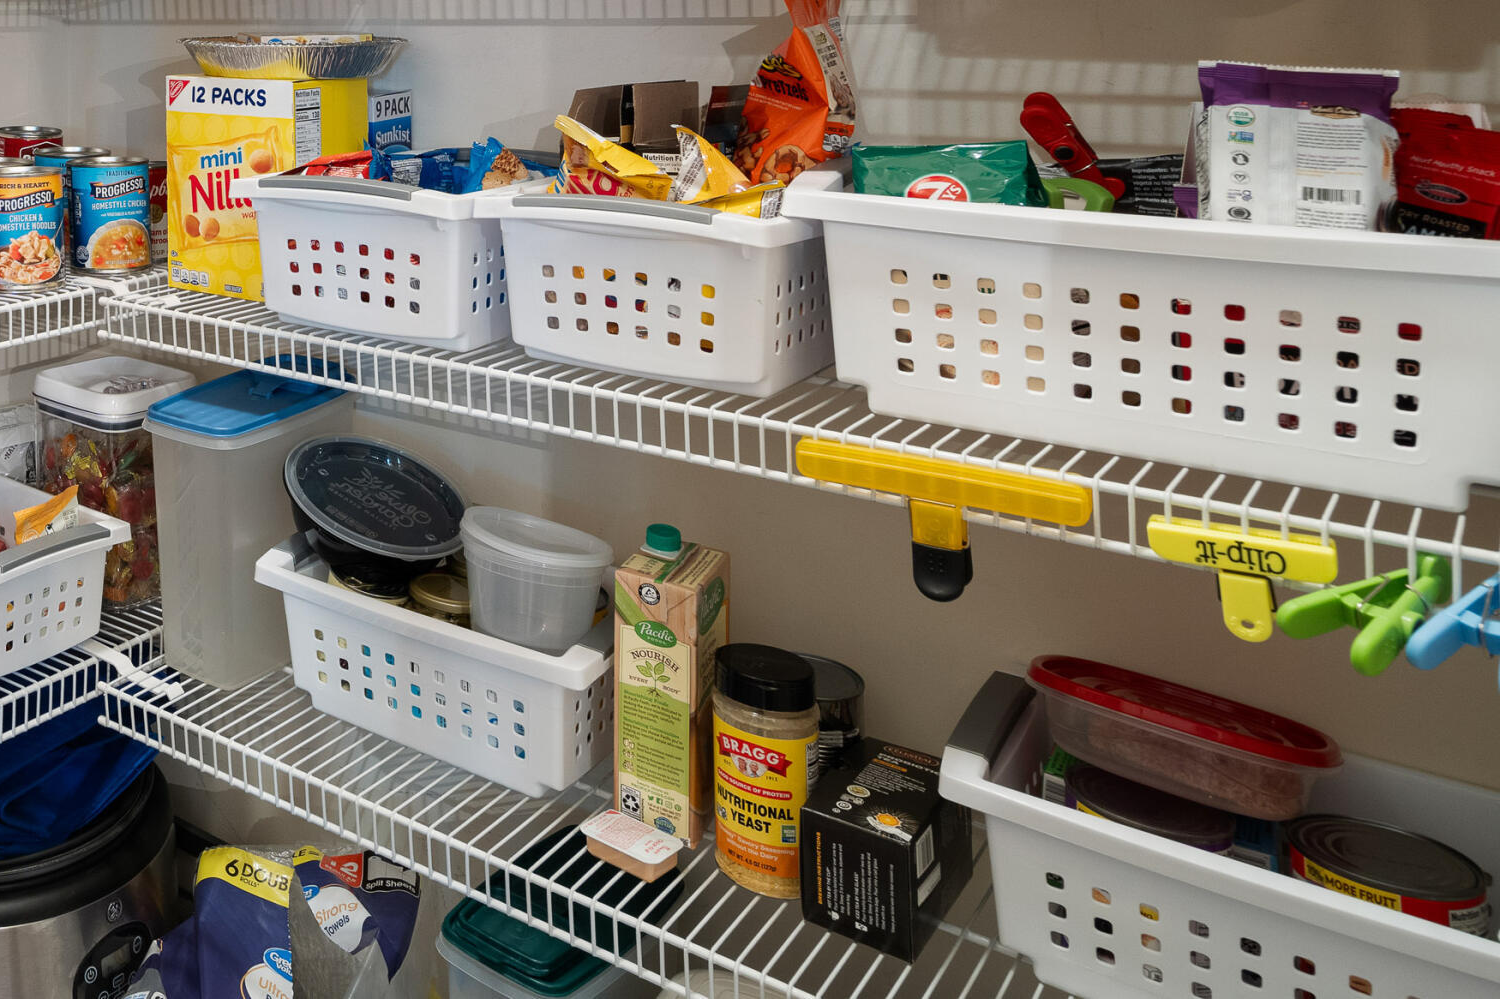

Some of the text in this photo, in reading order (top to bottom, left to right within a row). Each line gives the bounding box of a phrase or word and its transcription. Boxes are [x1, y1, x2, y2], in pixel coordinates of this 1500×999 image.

[191, 86, 267, 107] 12 PACKS
[376, 96, 410, 118] 9 PACK
[376, 124, 412, 146] Sunkist
[200, 147, 243, 169] mini
[644, 153, 674, 163] Nutrition
[1411, 154, 1496, 178] Heart Healthy Snack
[23, 181, 50, 189] HEARTY
[95, 178, 144, 198] PROGRESSO
[92, 199, 147, 211] HOMESTYLE CHICKEN
[9, 212, 43, 223] CHICKEN &
[32, 221, 56, 230] NOODLES
[1399, 208, 1471, 233] DRY ROASTED
[1196, 540, 1287, 575] Clip-it
[639, 621, 675, 644] Pacific
[630, 649, 681, 673] NOURISH
[628, 674, 682, 695] EVERY BODY
[722, 735, 780, 766] BRAGG
[730, 778, 752, 793] SOURCE
[762, 790, 791, 799] PROTEIN
[717, 782, 794, 821] NUTRITIONAL
[730, 808, 771, 834] YEAST
[726, 837, 779, 863] without the Dairy
[737, 835, 795, 857] Savory Seasoning
[225, 859, 240, 876] 6
[366, 879, 417, 895] Split Sheets
[1324, 876, 1397, 909] MORE FRUIT
[315, 902, 358, 927] Strong
[324, 914, 350, 937] Towels
